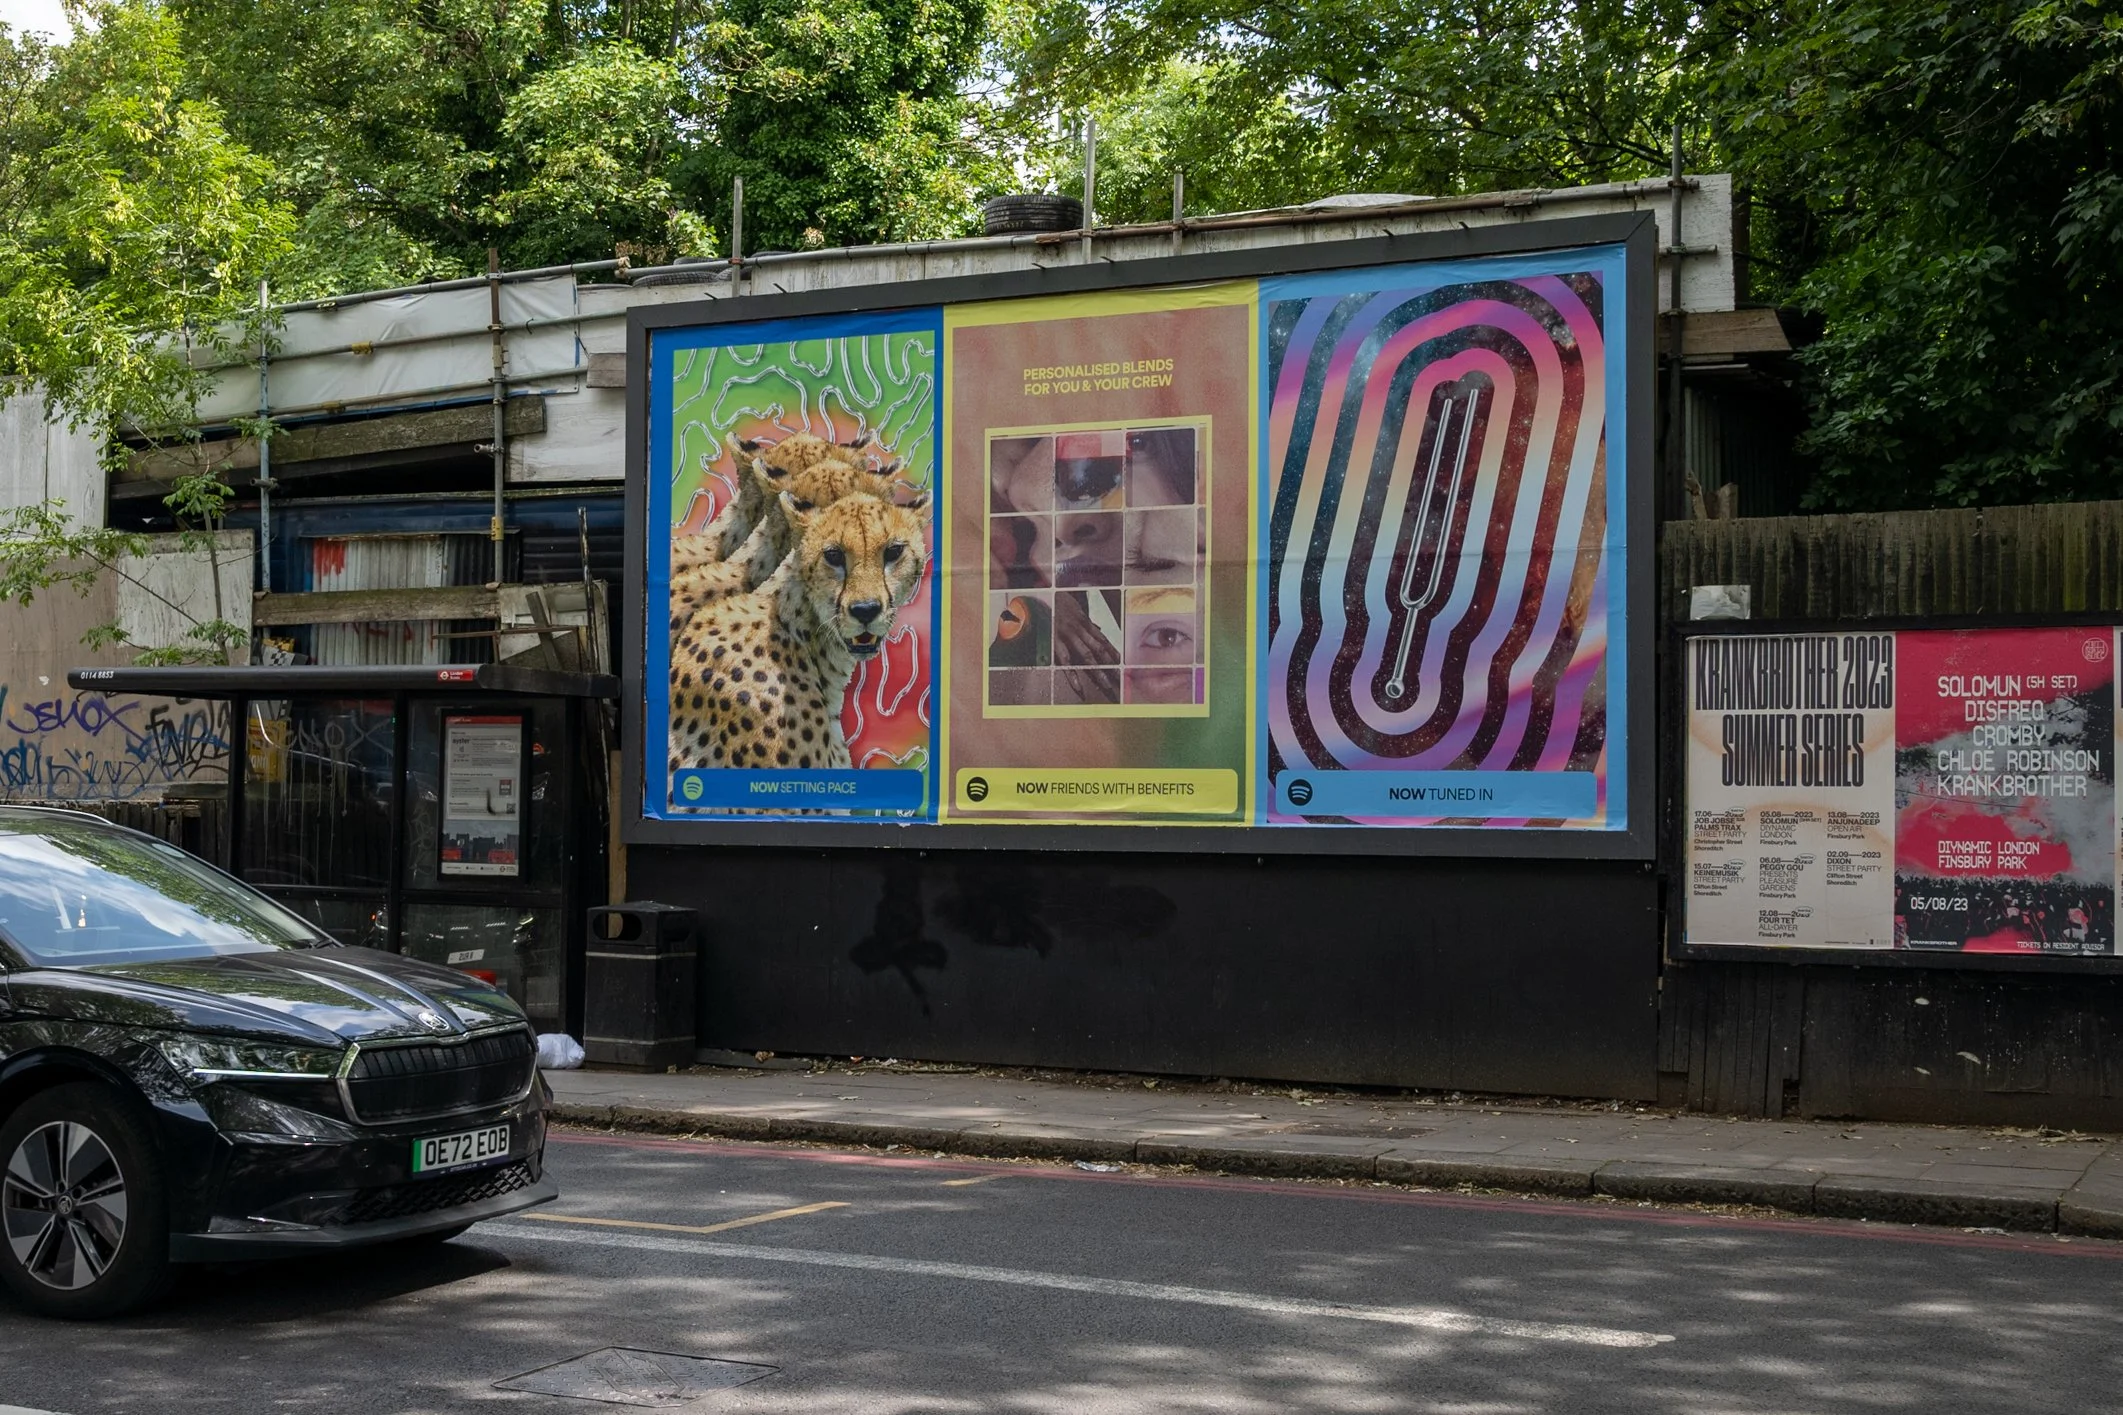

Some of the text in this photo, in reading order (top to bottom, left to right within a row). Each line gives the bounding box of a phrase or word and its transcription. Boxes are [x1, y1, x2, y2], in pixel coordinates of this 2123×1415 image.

[1023, 358, 1174, 381] PERSONALISED BLENDS
[1024, 374, 1173, 396] FOR YOU & YOUR CREW
[1695, 636, 1893, 710] KRANKBROTHER 2023
[1937, 675, 2078, 697] SOLOMUN (5H SET)
[1965, 700, 2044, 722] DISFREQ
[1973, 725, 2046, 746] CROMBY
[1721, 713, 1864, 787] SUMMER SERIES
[2007, 750, 2100, 771] ROBINSON
[749, 781, 857, 794] NOW SETTING PACE
[1016, 782, 1195, 796] NOW FRIENDS WITH BENEFITS
[1937, 775, 2087, 796] KRANKBROTHER
[1389, 787, 1493, 801] NOW TUNED IN
[1760, 817, 1798, 825] SOLOMUN
[1760, 824, 1797, 832] DIYNAMIC
[1827, 818, 1881, 826] ANJUNADEEP
[1760, 831, 1793, 839] LONDON
[1938, 840, 2040, 855] DIYNAMIC LONDON
[1786, 864, 1804, 872] GOU
[1938, 855, 2027, 870] FINSBURY PARK
[1759, 877, 1798, 885] PLEASURE
[1759, 884, 1796, 892] GARDENS
[1910, 897, 1969, 911] 05/08/23
[2052, 942, 2079, 950] RESIDENT
[425, 1127, 508, 1166] OE72 EOB
